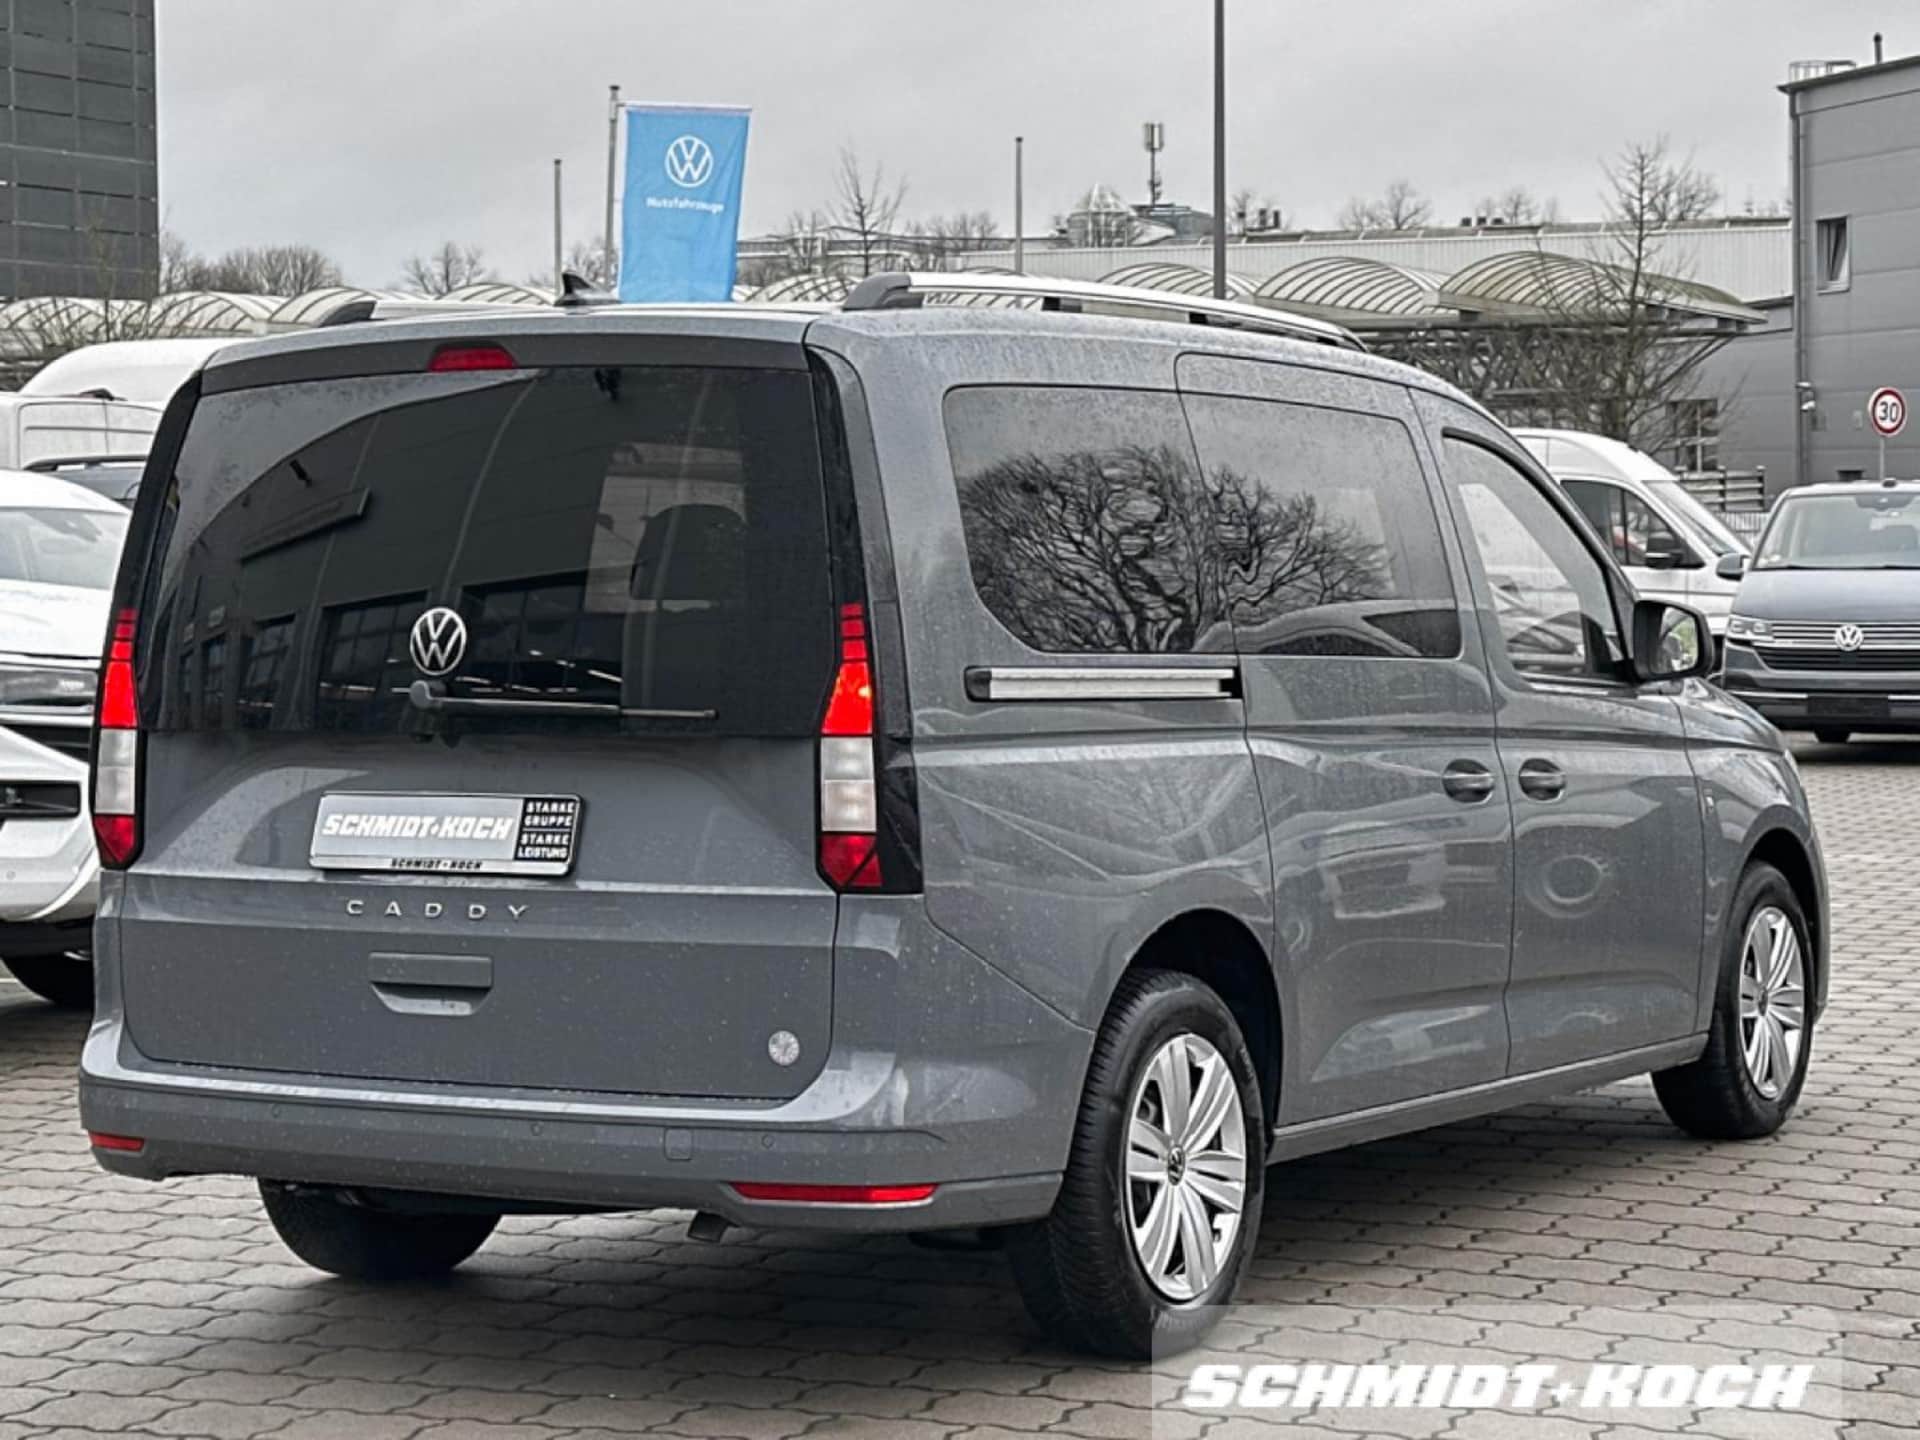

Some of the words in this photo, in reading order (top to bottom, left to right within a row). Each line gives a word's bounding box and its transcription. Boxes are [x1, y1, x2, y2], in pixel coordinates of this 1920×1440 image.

[1879, 401, 1900, 422] 30
[526, 802, 575, 813] STARKE
[524, 815, 573, 827] GRUPPE
[521, 833, 570, 845] STARKE
[518, 847, 568, 859] LEISTUNG
[346, 900, 528, 919] CADDY
